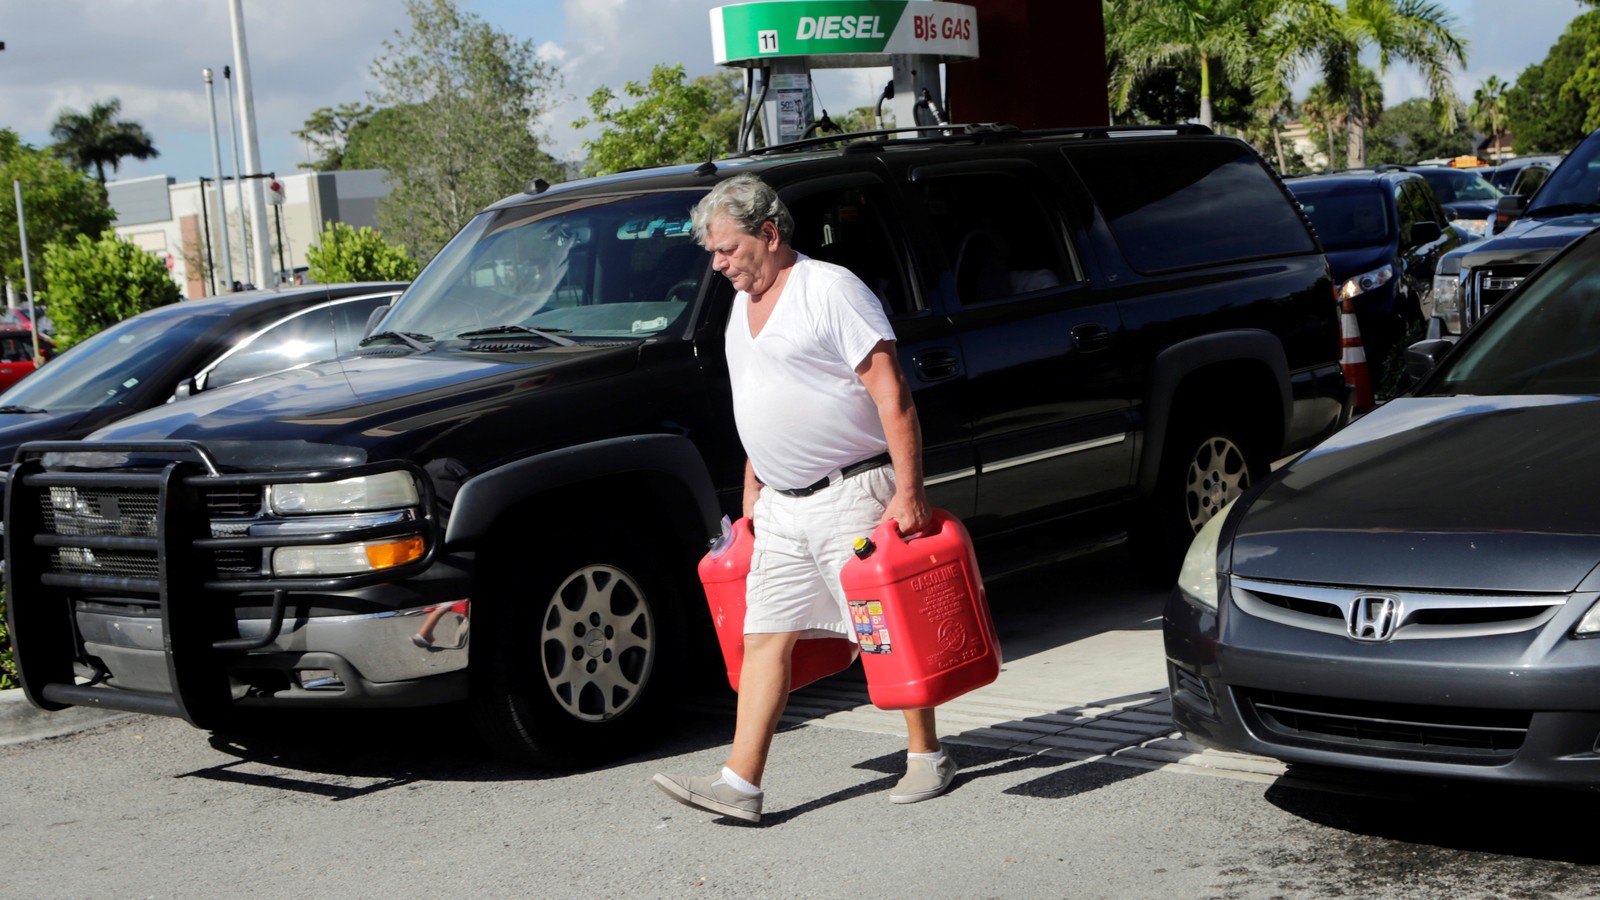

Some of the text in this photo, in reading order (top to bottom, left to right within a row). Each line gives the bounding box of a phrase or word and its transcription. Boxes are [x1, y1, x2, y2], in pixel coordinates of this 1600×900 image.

[796, 16, 885, 40] DIESEL
[914, 14, 971, 41] BJ's GAS
[760, 34, 777, 50] 11
[910, 565, 958, 592] GASOLINE
